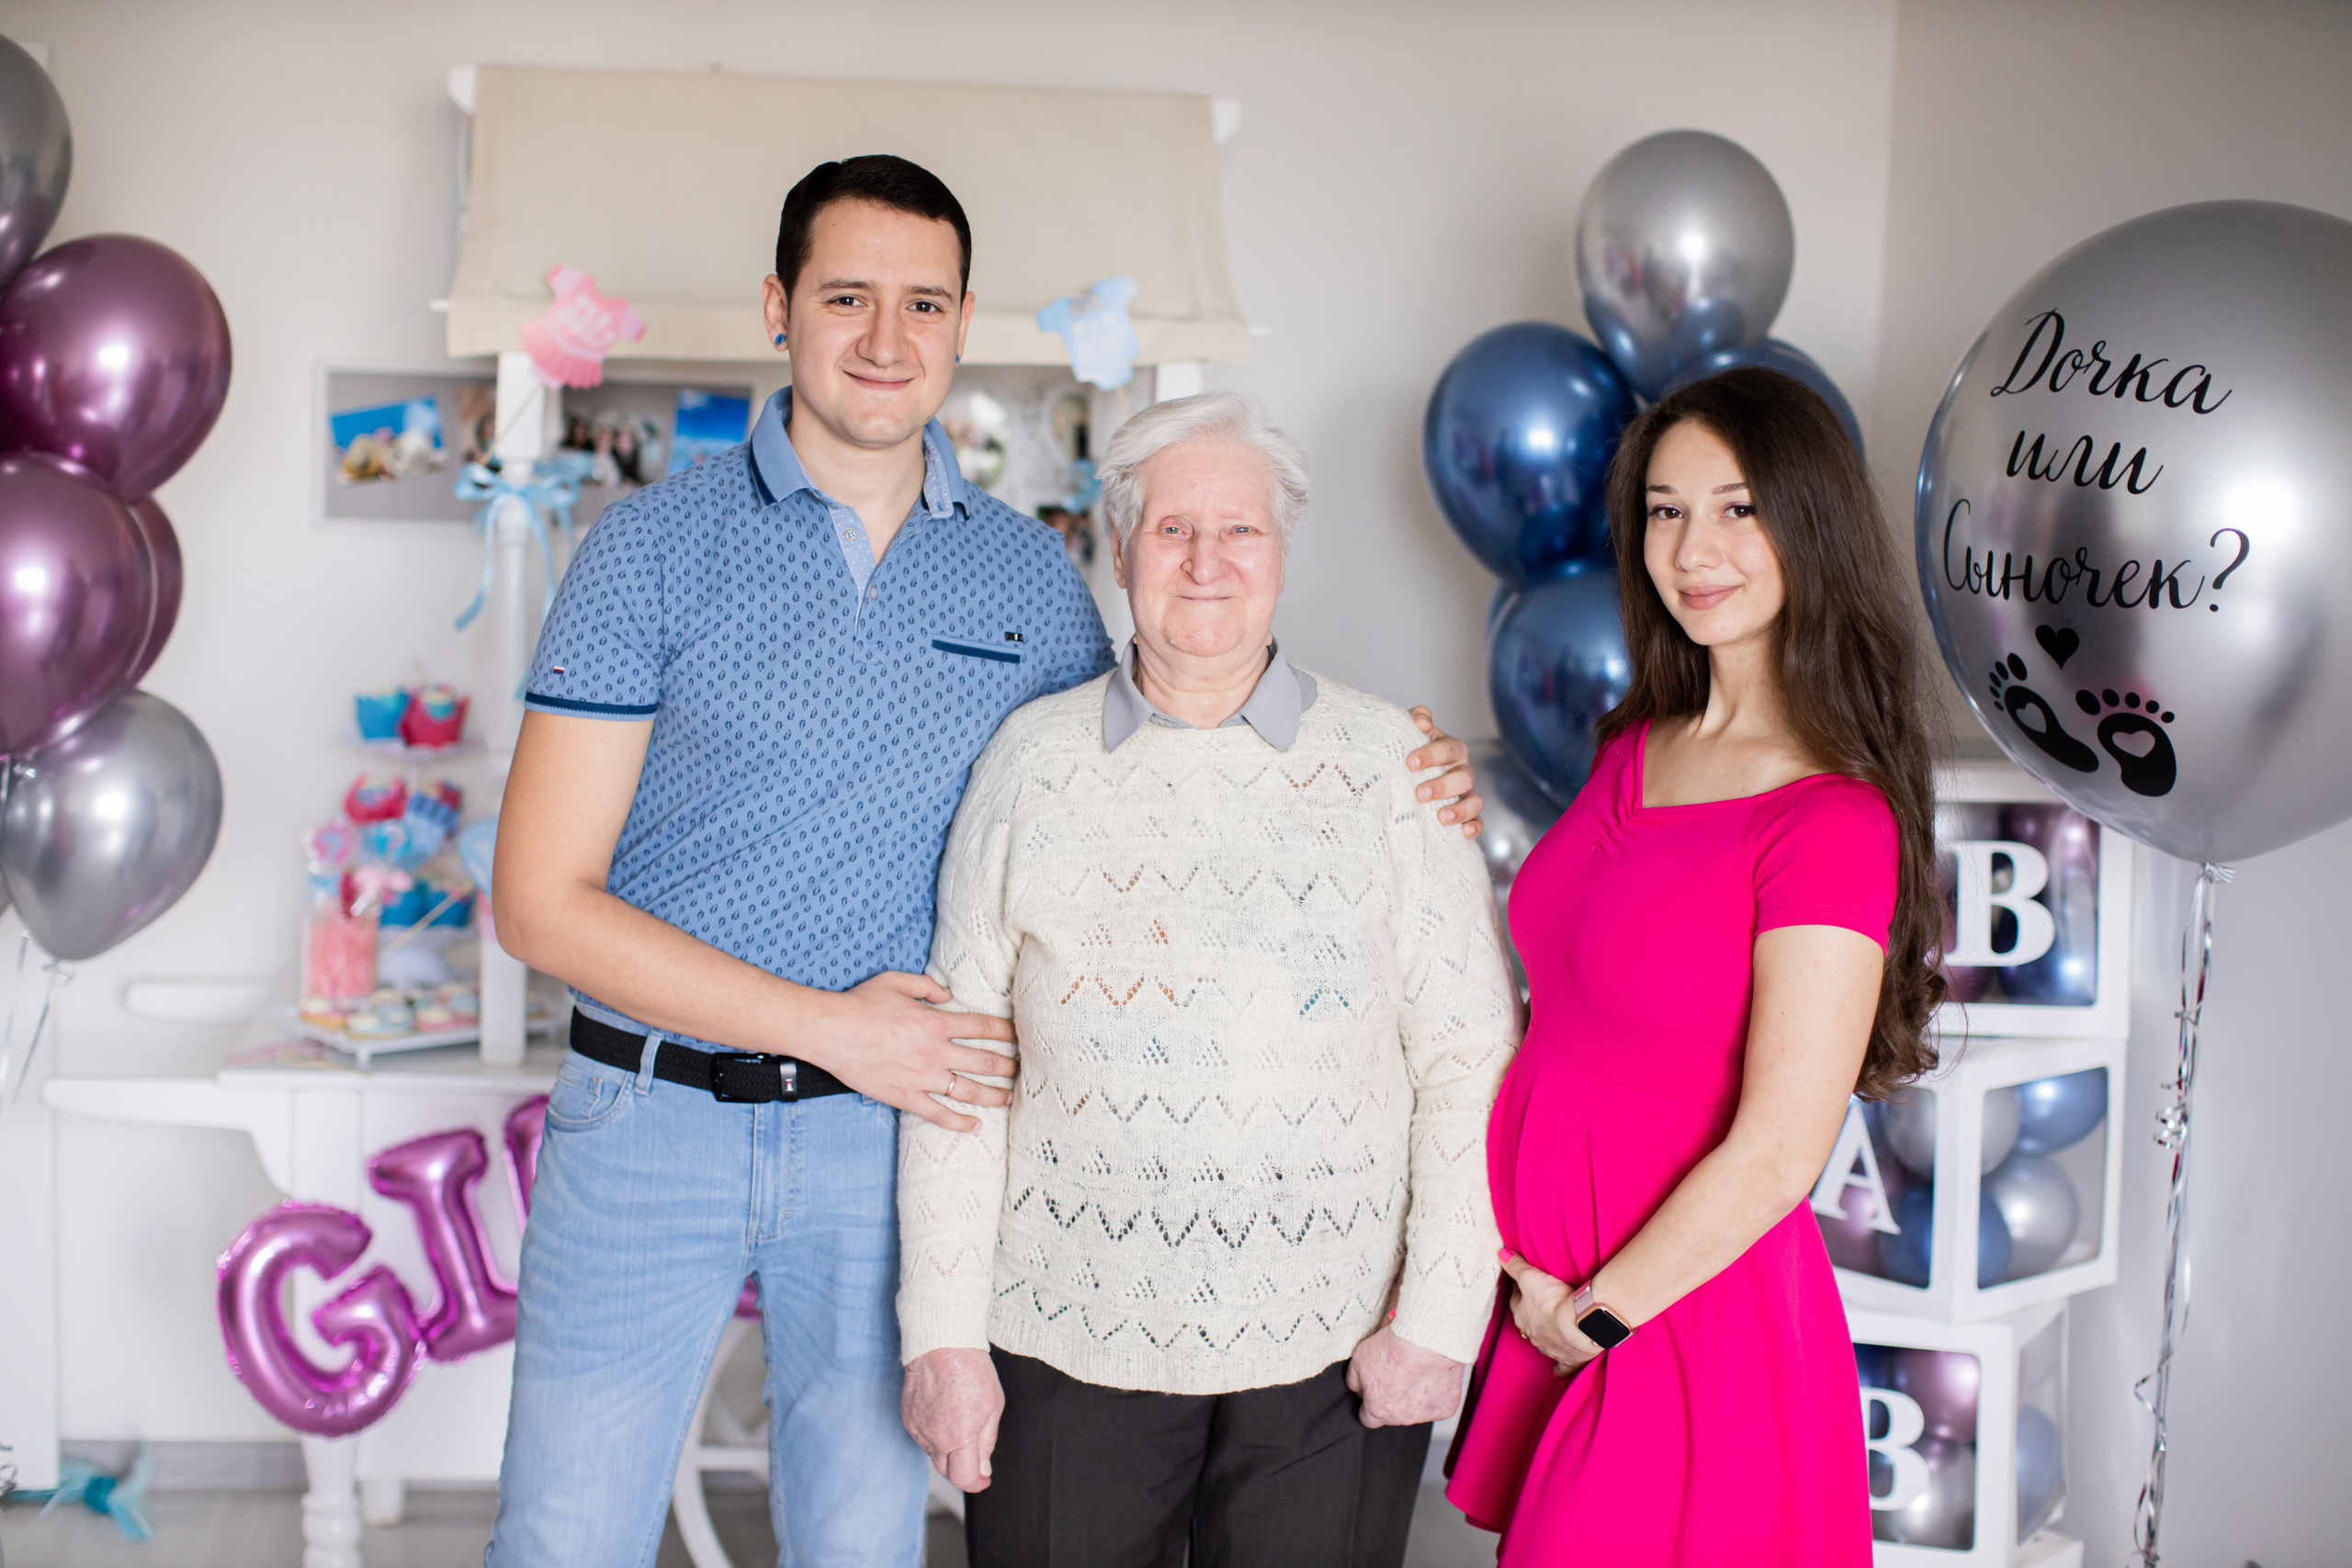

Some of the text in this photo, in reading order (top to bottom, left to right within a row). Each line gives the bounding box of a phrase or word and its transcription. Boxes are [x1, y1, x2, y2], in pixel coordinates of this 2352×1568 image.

[1989, 308, 2233, 415] Дочка
[2005, 429, 2165, 495] или
[1942, 498, 2251, 614] Сыночек?
[1942, 840, 2056, 967] B
[1809, 1097, 1903, 1235] A
[217, 1094, 552, 1439] GI
